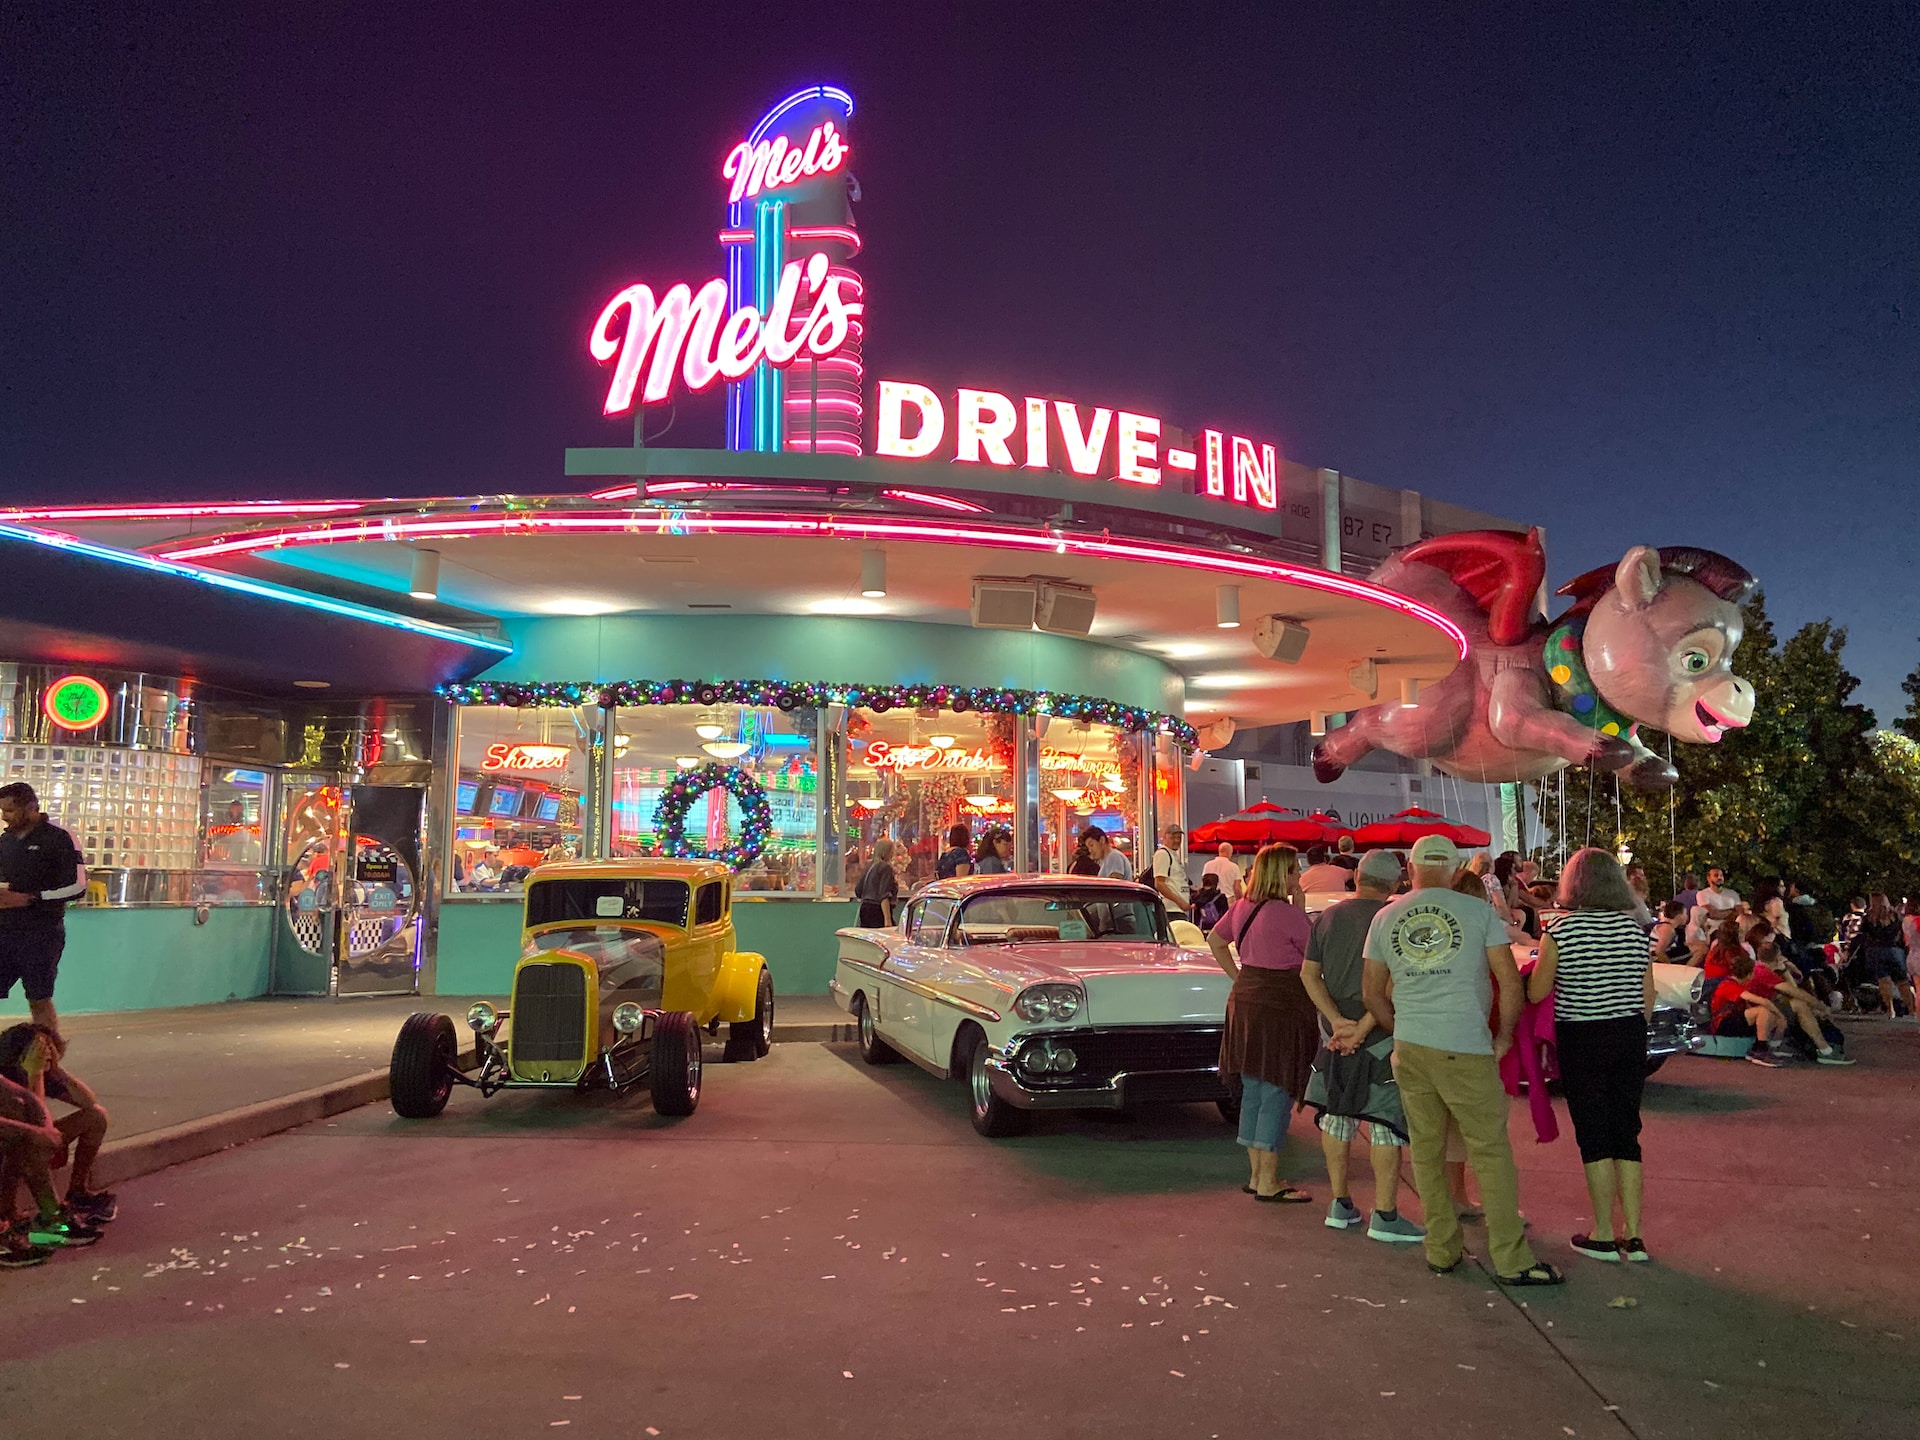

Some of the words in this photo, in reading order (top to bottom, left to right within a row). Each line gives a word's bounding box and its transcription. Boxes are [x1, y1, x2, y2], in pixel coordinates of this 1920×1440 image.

[723, 121, 848, 202] Mel's
[590, 252, 864, 415] Mel's
[875, 380, 1277, 509] DRIVE-IN
[1343, 516, 1364, 538] 87
[1372, 523, 1392, 545] E7
[482, 743, 566, 770] Shakes
[863, 741, 916, 773] Soft
[919, 746, 993, 770] Drinks
[1040, 746, 1121, 779] Hamburgers
[371, 900, 393, 908] ONLY
[374, 892, 391, 900] EXIT
[1407, 905, 1441, 918] CLAM
[1442, 912, 1462, 951] SHACK
